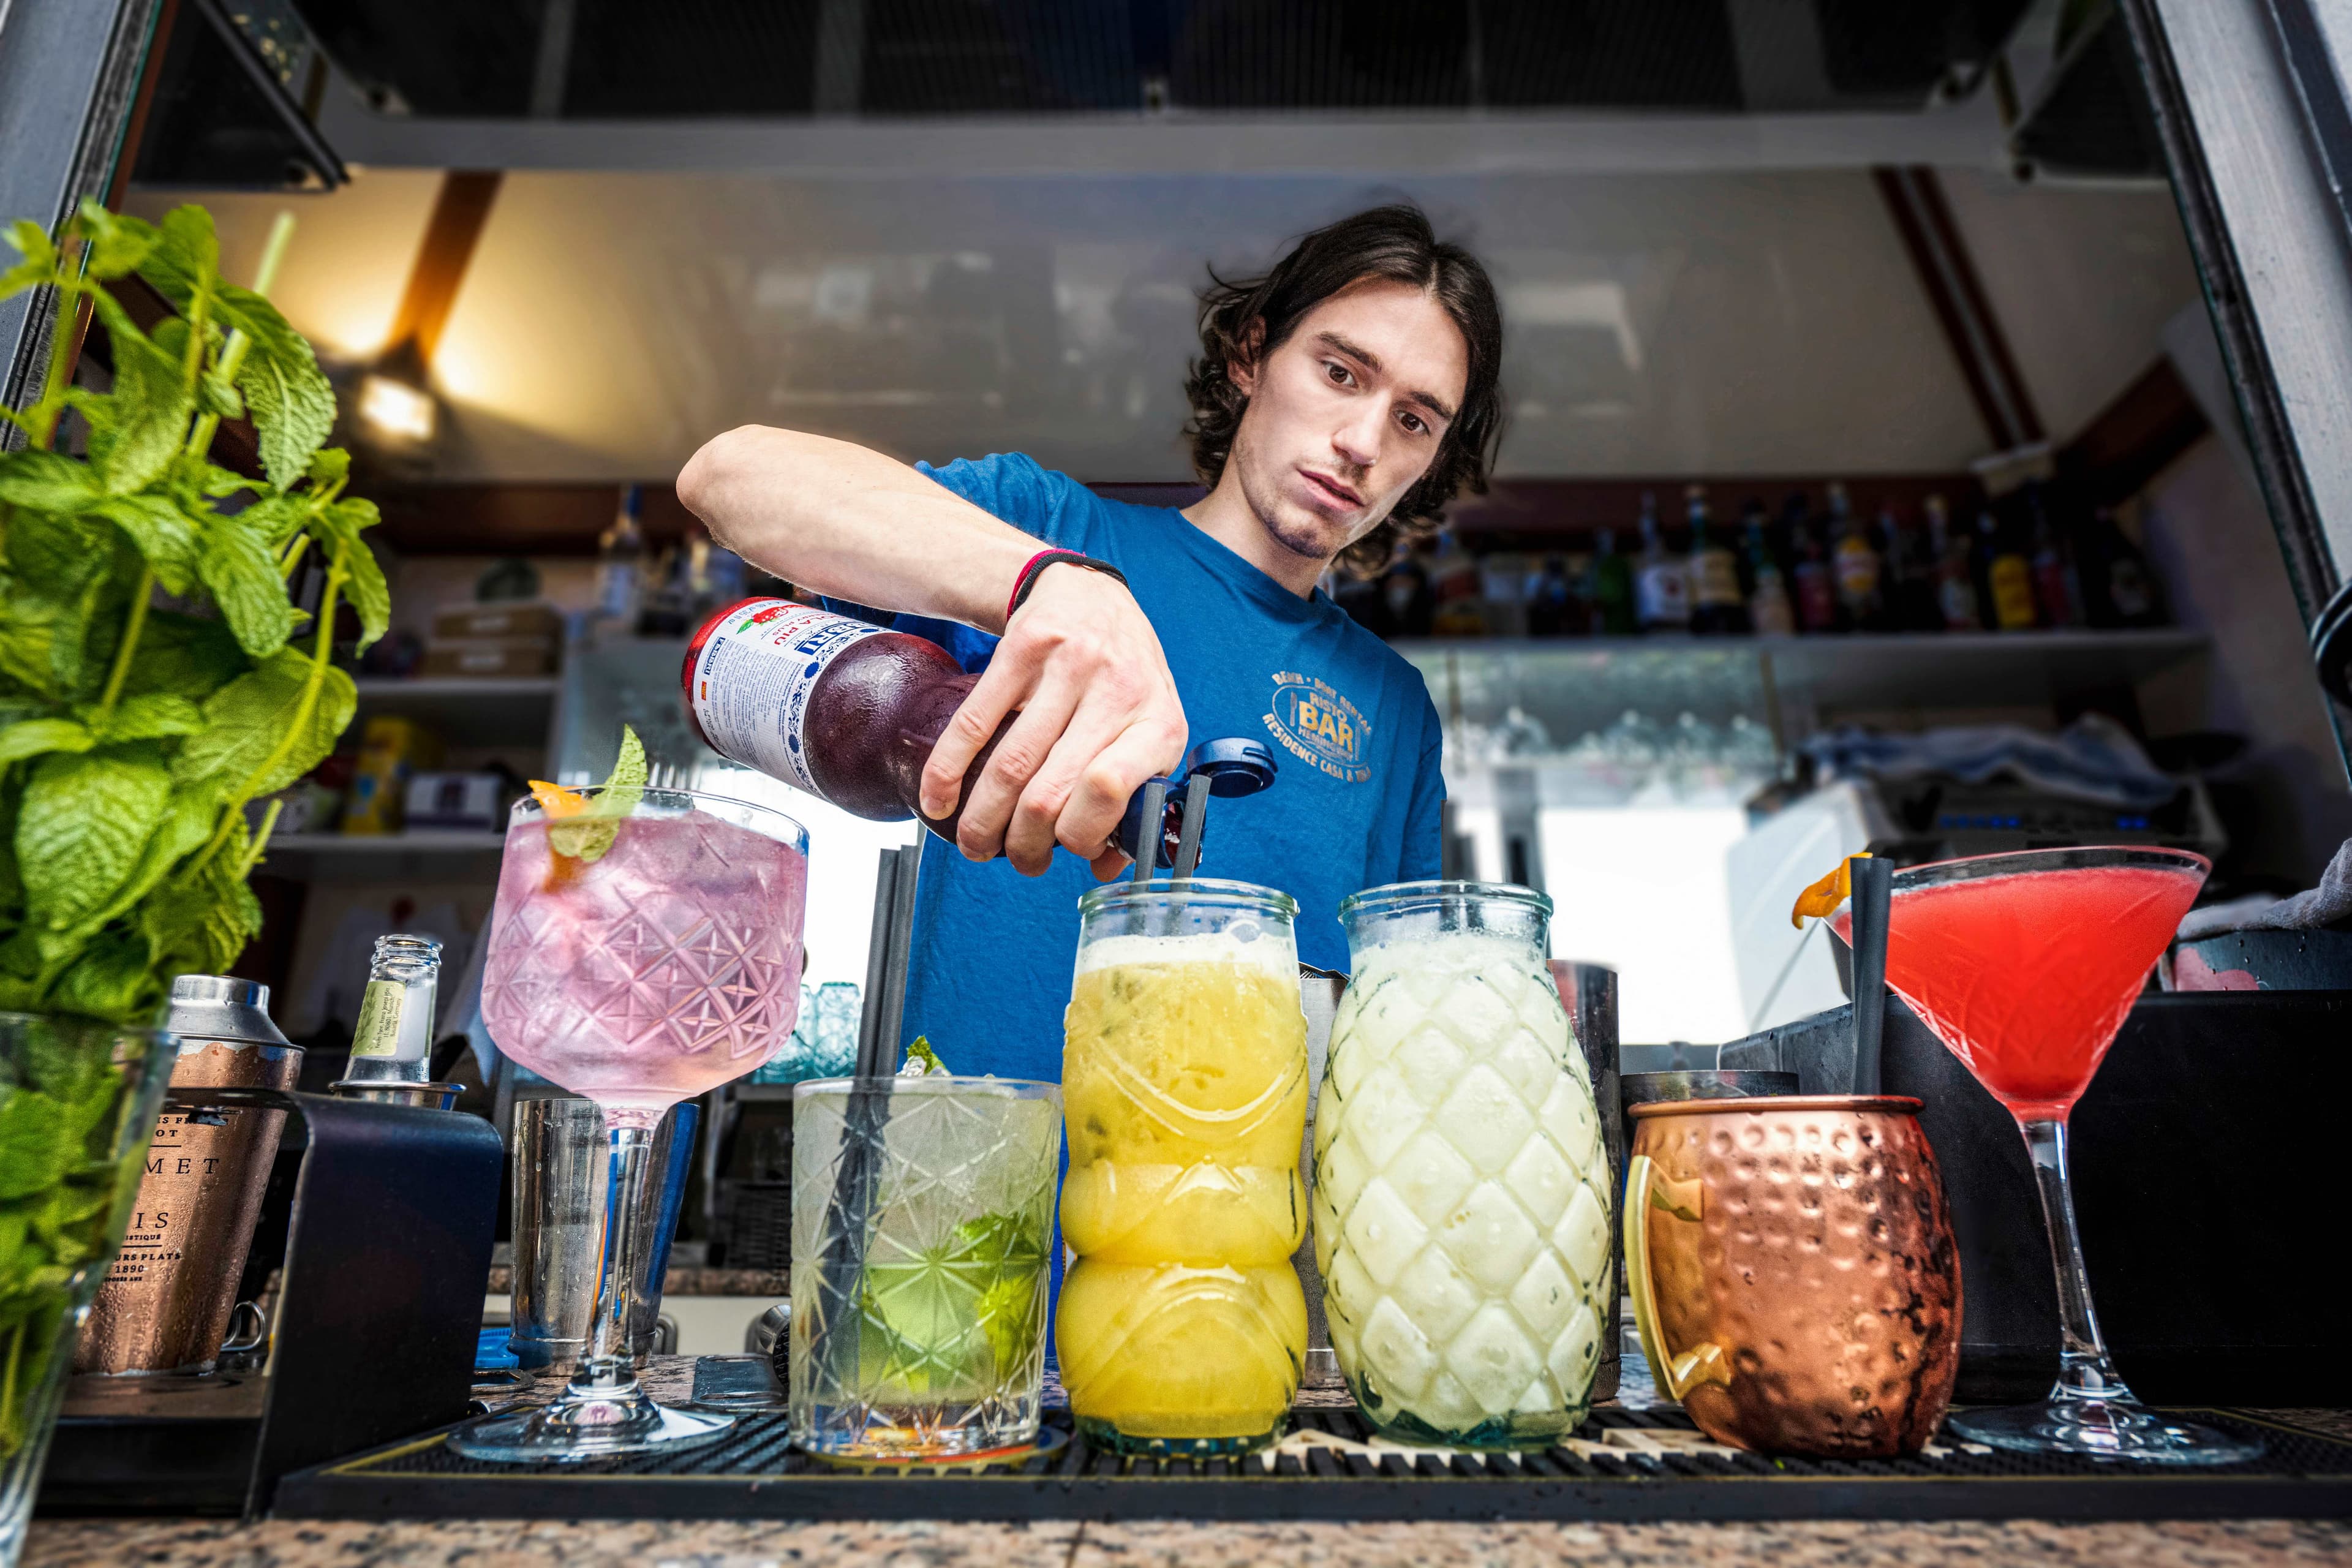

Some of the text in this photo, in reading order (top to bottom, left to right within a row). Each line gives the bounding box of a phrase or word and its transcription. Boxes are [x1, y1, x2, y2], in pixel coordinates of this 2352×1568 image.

[1310, 692, 1348, 723] RISTO
[1299, 701, 1354, 753] BAR
[1262, 713, 1318, 766] RESIDENCE
[1321, 760, 1344, 780] CASA
[147, 1158, 219, 1174] MET
[135, 1212, 169, 1229] IS
[141, 1253, 181, 1261] PLATS
[115, 1265, 145, 1273] 1890
